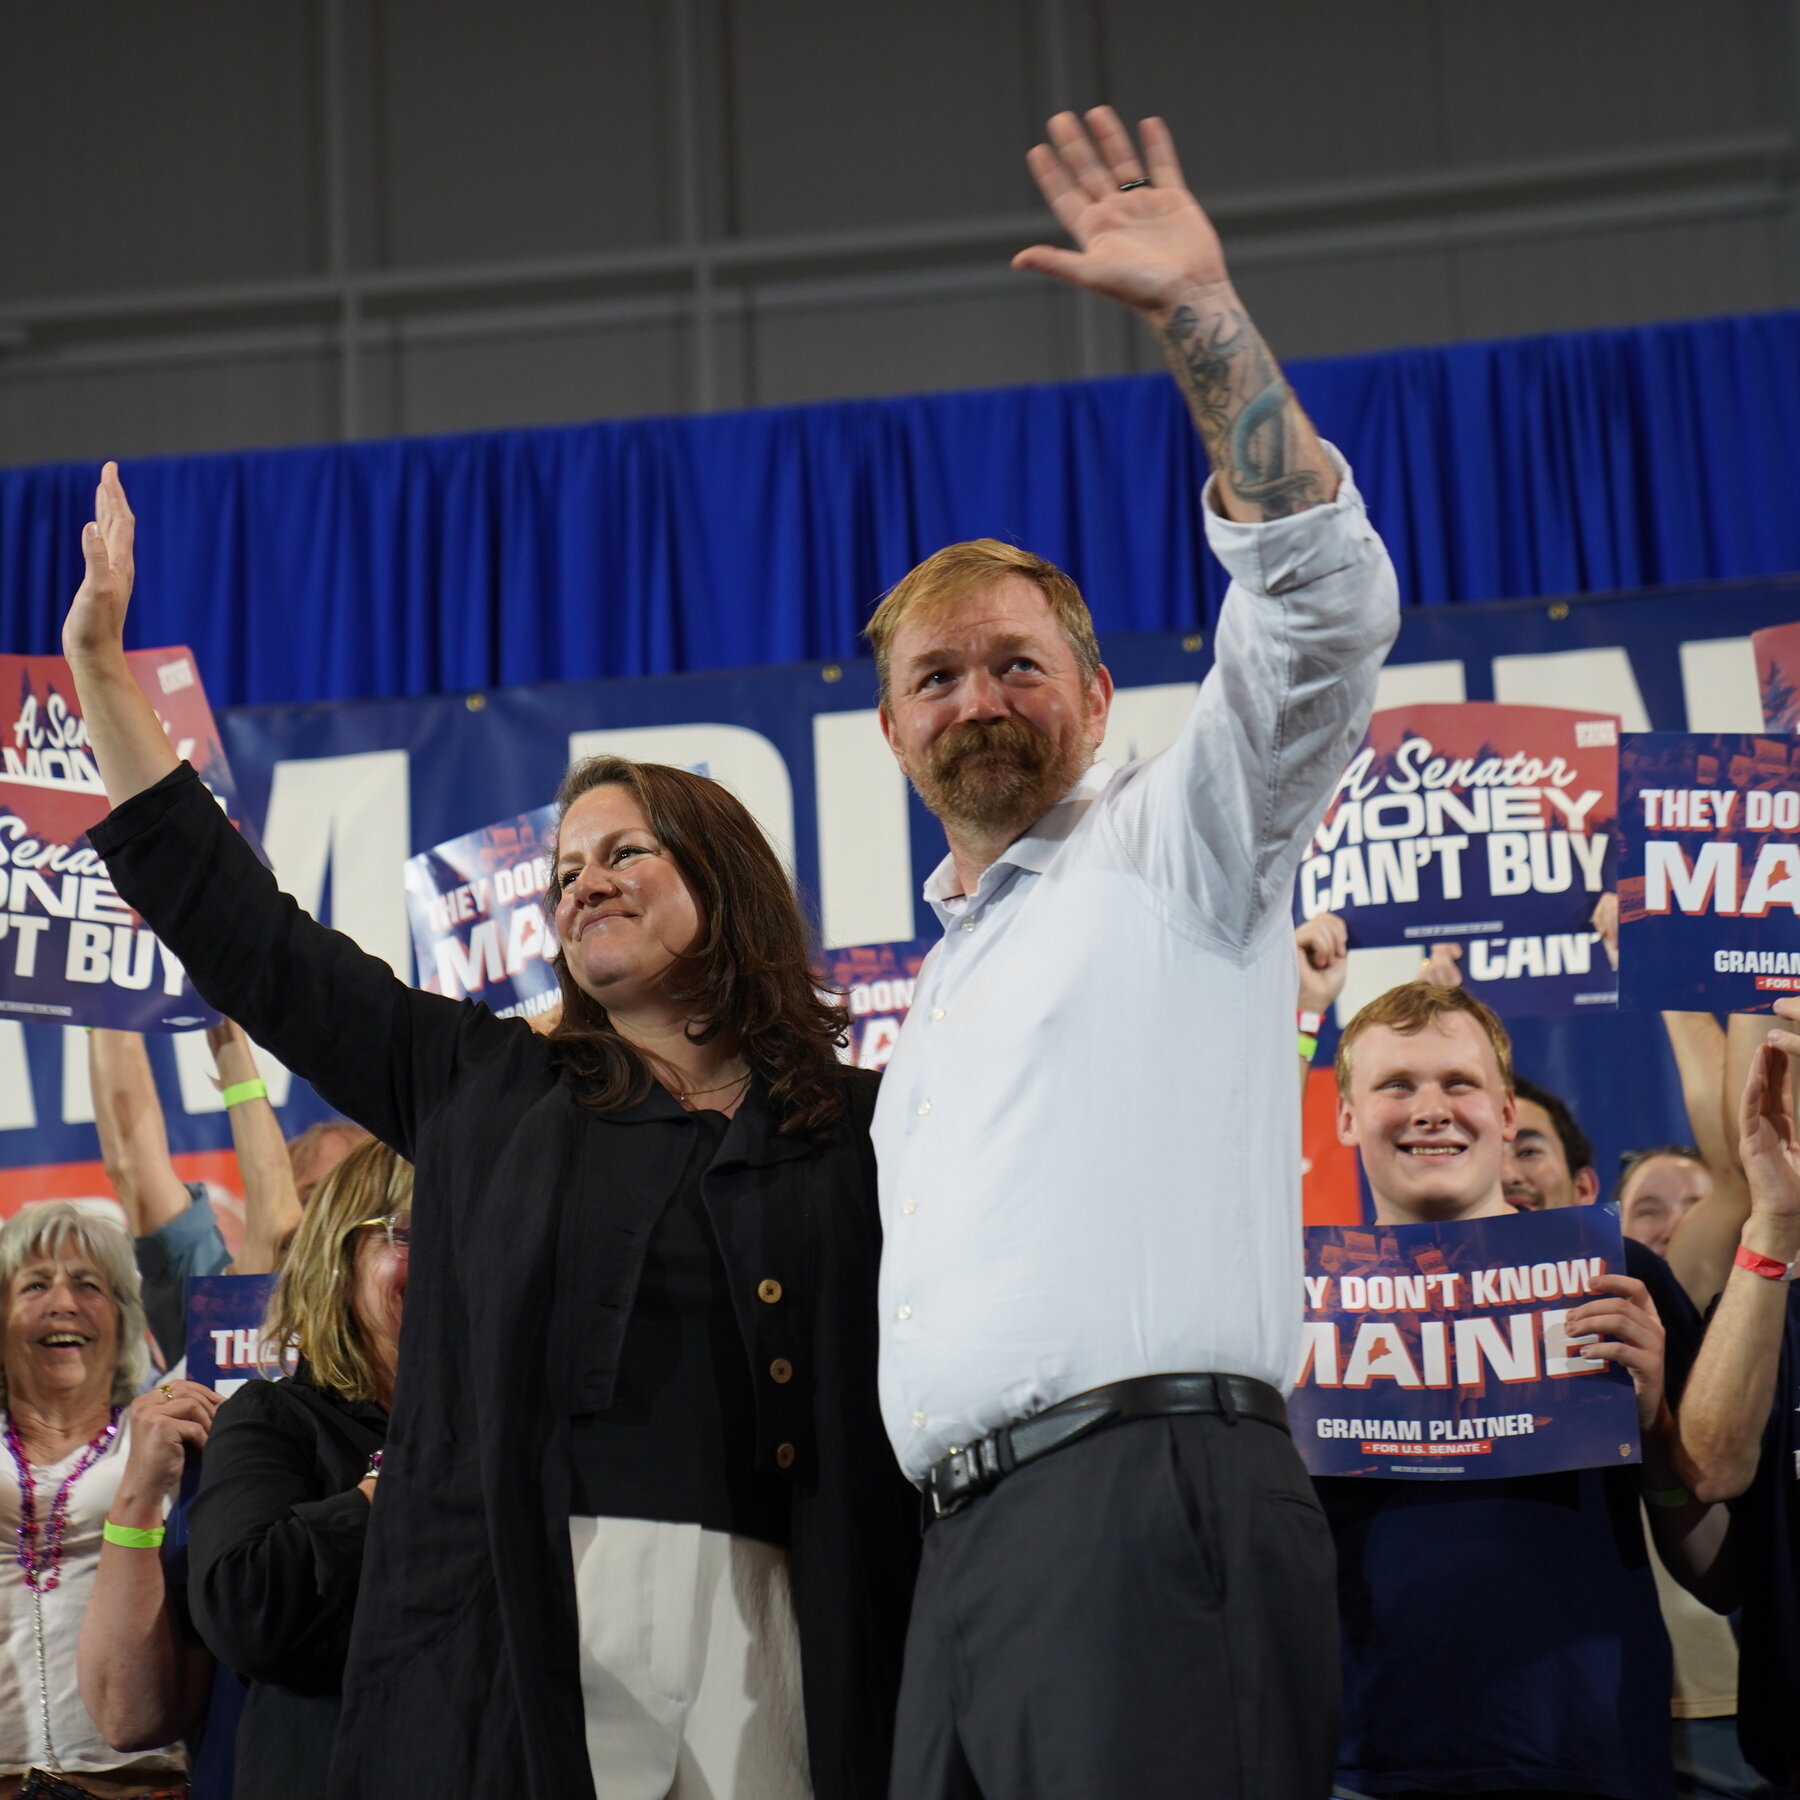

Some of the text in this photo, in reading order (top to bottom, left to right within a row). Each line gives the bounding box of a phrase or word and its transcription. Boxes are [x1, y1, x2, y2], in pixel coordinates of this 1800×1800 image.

[13, 694, 45, 749] A
[1328, 737, 1578, 809] A Senator
[1302, 786, 1604, 862] MONEY
[1638, 788, 1738, 830] THEY
[1300, 830, 1609, 922] CAN'T BUY
[65, 919, 187, 997] BUY
[1766, 977, 1792, 990] FOR
[1340, 1272, 1460, 1310] DON'T
[1471, 1256, 1602, 1306] KNOW
[1294, 1307, 1606, 1387] MAINE
[1316, 1412, 1535, 1441] GRAHAM PLATNER
[1372, 1443, 1481, 1455] FOR U.S. SENATE
